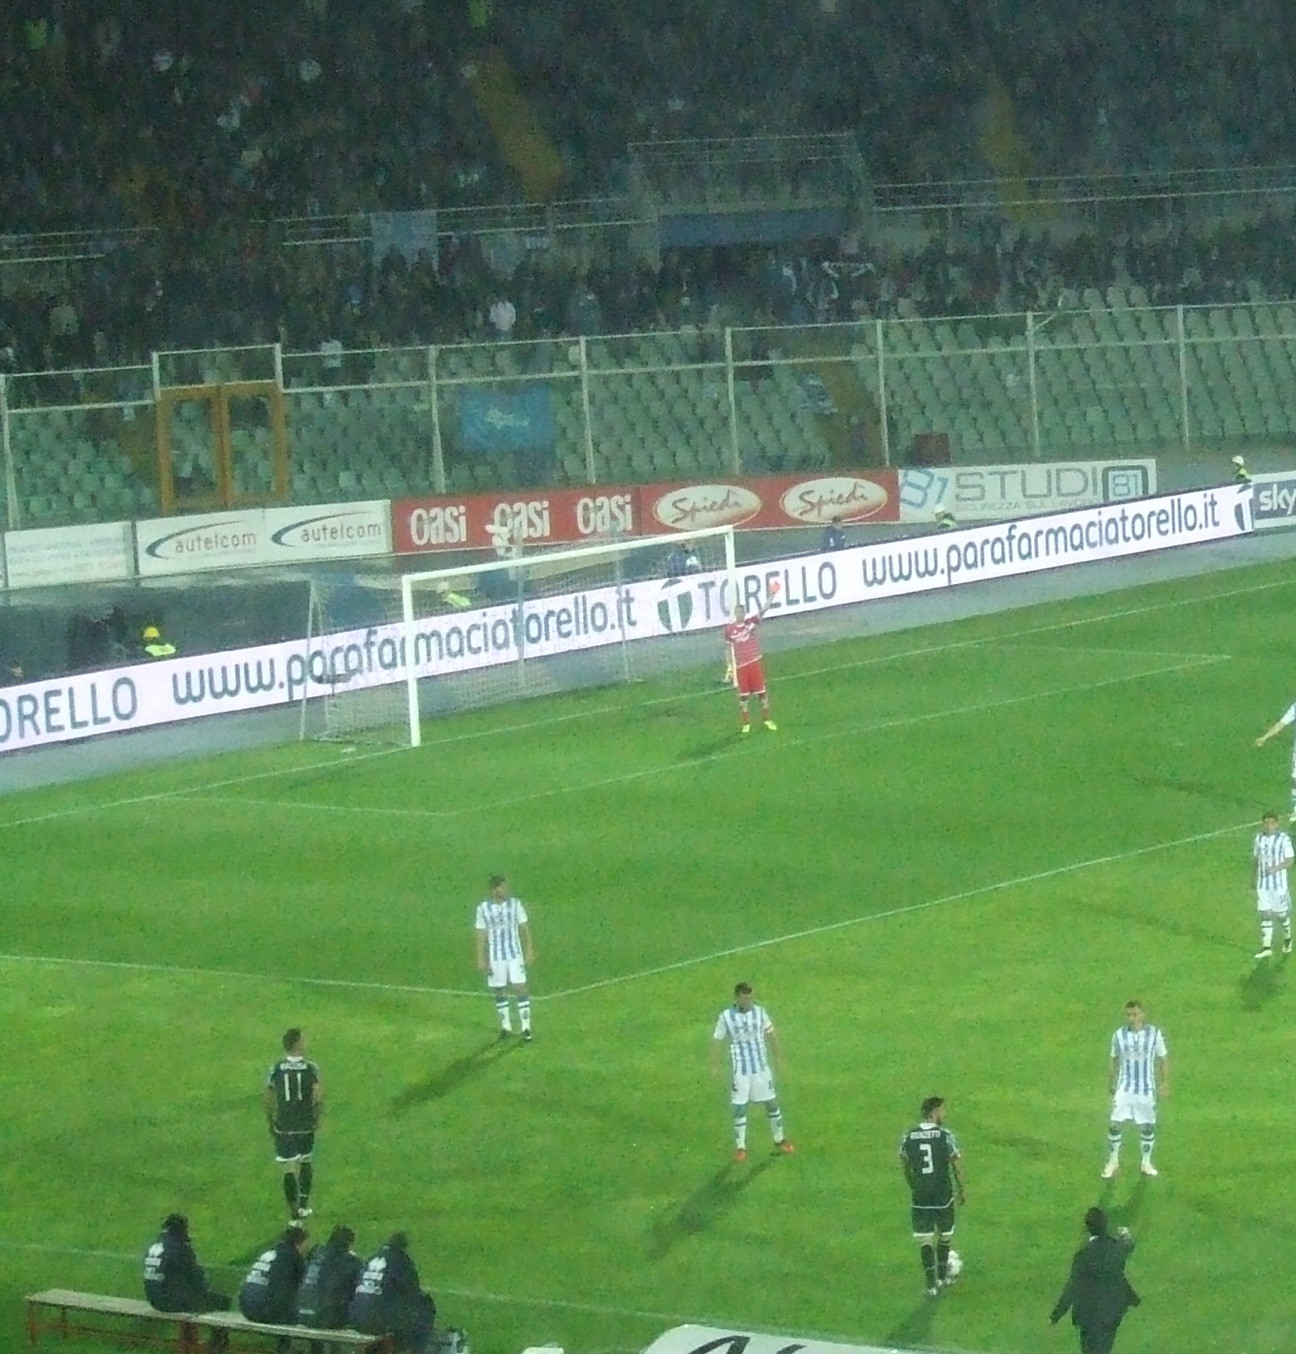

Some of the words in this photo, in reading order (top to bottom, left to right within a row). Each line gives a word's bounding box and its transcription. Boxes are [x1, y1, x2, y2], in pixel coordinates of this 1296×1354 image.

[175, 530, 257, 554] autelcom
[300, 521, 382, 543] autelcom
[862, 493, 1221, 586] www.parafarmaciatorello.it
[283, 1072, 303, 1102] 11
[919, 1143, 934, 1175] 3
